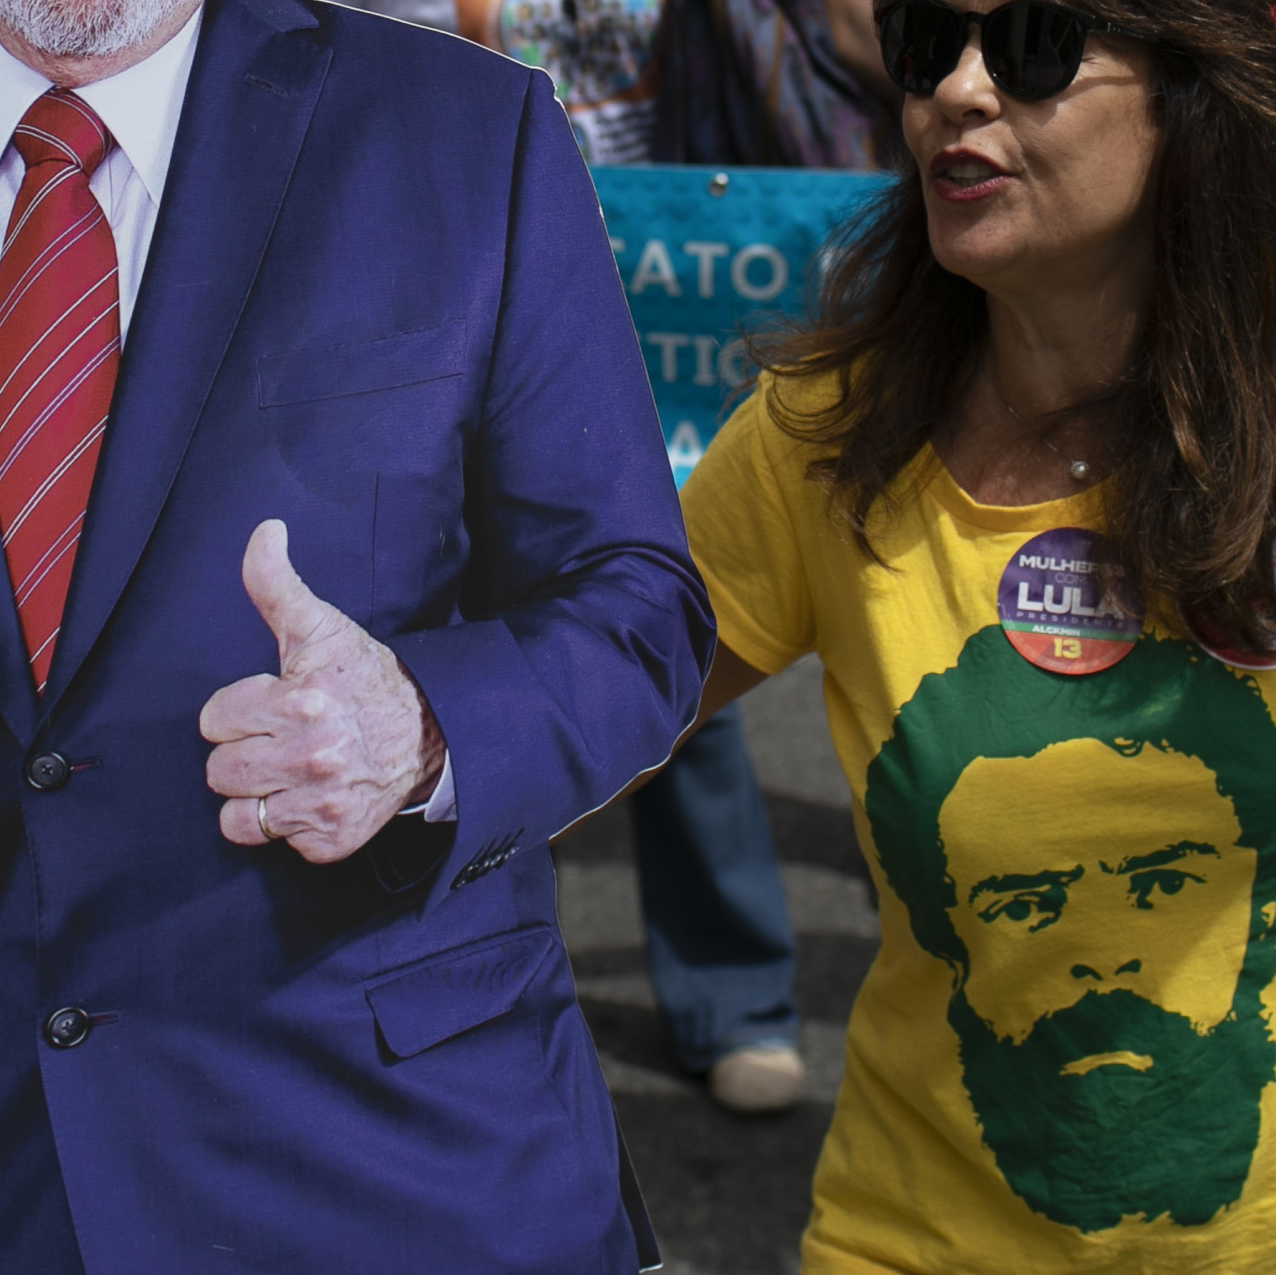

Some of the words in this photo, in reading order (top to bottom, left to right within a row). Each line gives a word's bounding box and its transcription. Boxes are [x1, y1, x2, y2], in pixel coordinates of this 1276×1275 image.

[1017, 582, 1124, 620] LULA
[1016, 611, 1124, 628] PRESIDENTE
[1031, 625, 1081, 636] ALCKMIN
[1052, 637, 1082, 659] 13
